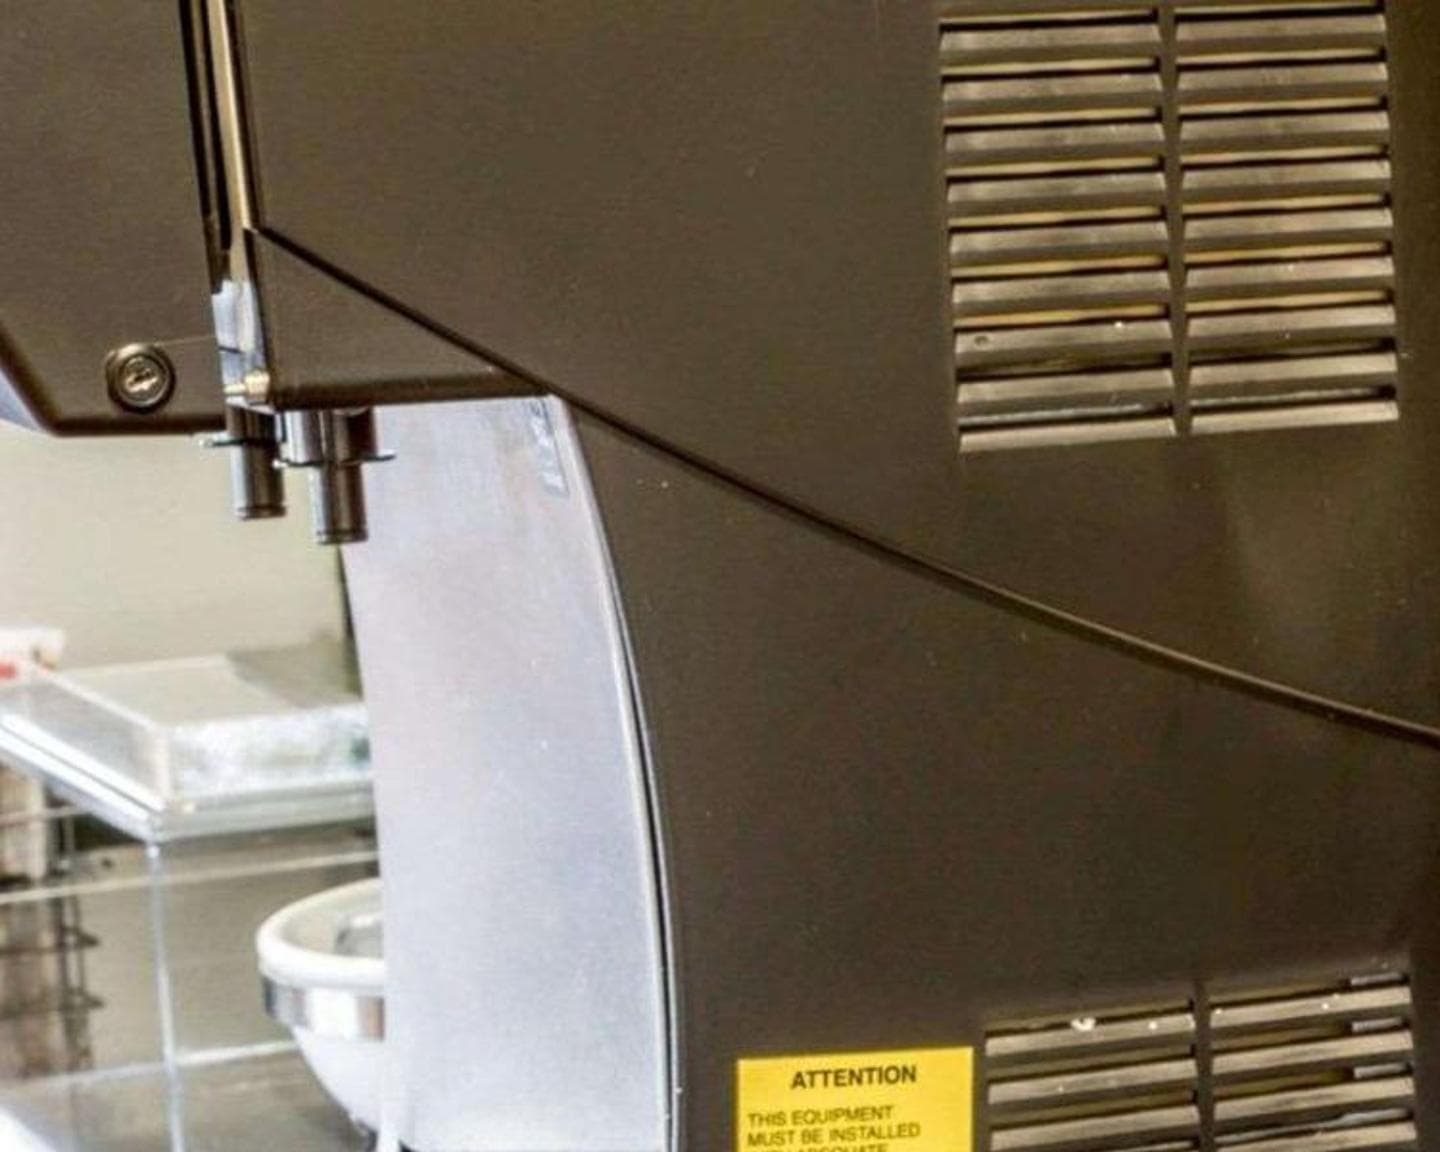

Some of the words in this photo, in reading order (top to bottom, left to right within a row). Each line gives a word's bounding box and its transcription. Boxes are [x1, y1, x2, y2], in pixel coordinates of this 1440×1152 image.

[790, 1065, 917, 1090] ATTENTION
[747, 1111, 787, 1127] THIS
[791, 1105, 894, 1126] EQUIPMENT
[748, 1129, 795, 1147] MUST
[801, 1127, 824, 1145] BE
[829, 1122, 921, 1142] INSTALLED
